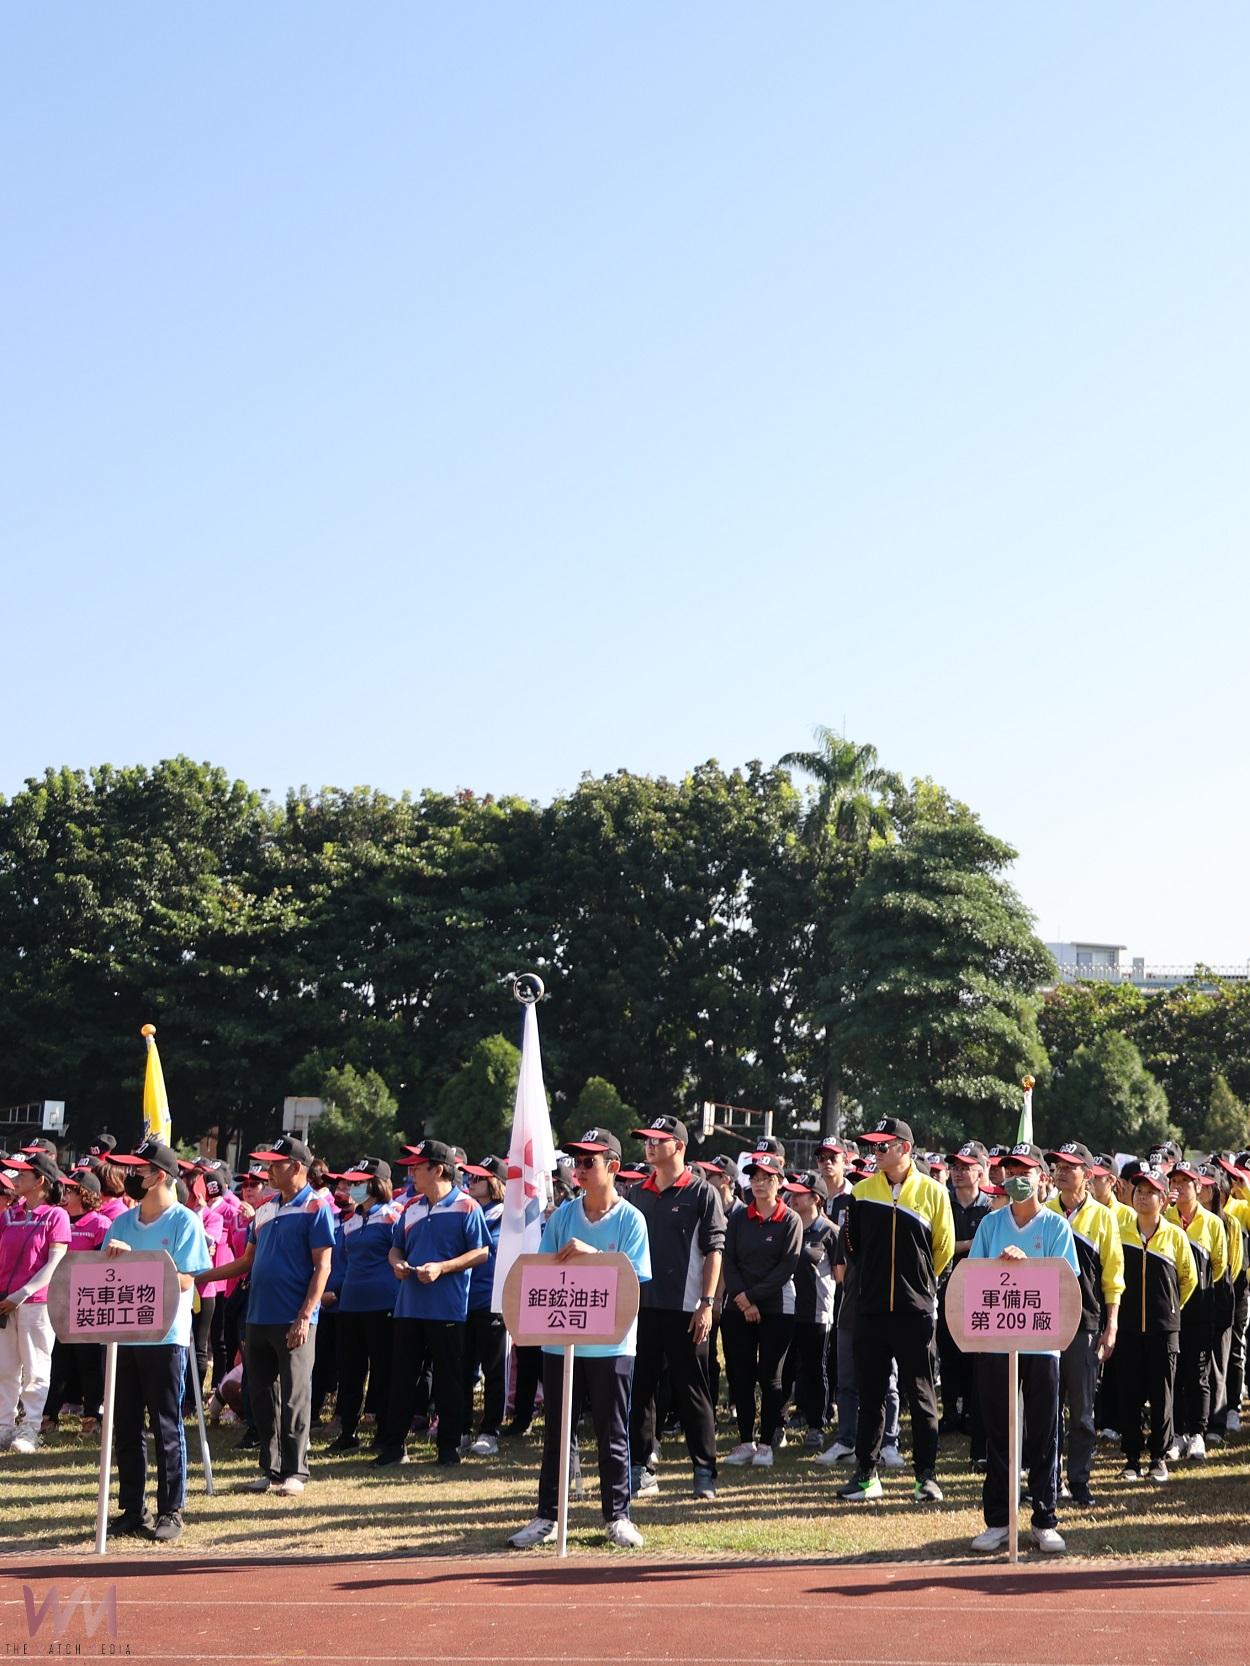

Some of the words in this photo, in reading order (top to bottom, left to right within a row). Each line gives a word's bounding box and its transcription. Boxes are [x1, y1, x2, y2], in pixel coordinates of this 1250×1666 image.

[105, 1268, 122, 1283] 3.
[560, 1271, 575, 1285] 1.
[1000, 1272, 1017, 1286] 2.
[77, 1284, 156, 1306] 汽車貨物
[528, 1288, 609, 1308] 鉅鋐油封
[982, 1290, 1042, 1309] 軍備局
[76, 1305, 155, 1327] 裝卸工會
[548, 1310, 588, 1329] 公司
[971, 1311, 991, 1331] 第
[996, 1312, 1027, 1330] 209
[1032, 1311, 1052, 1331] 廠
